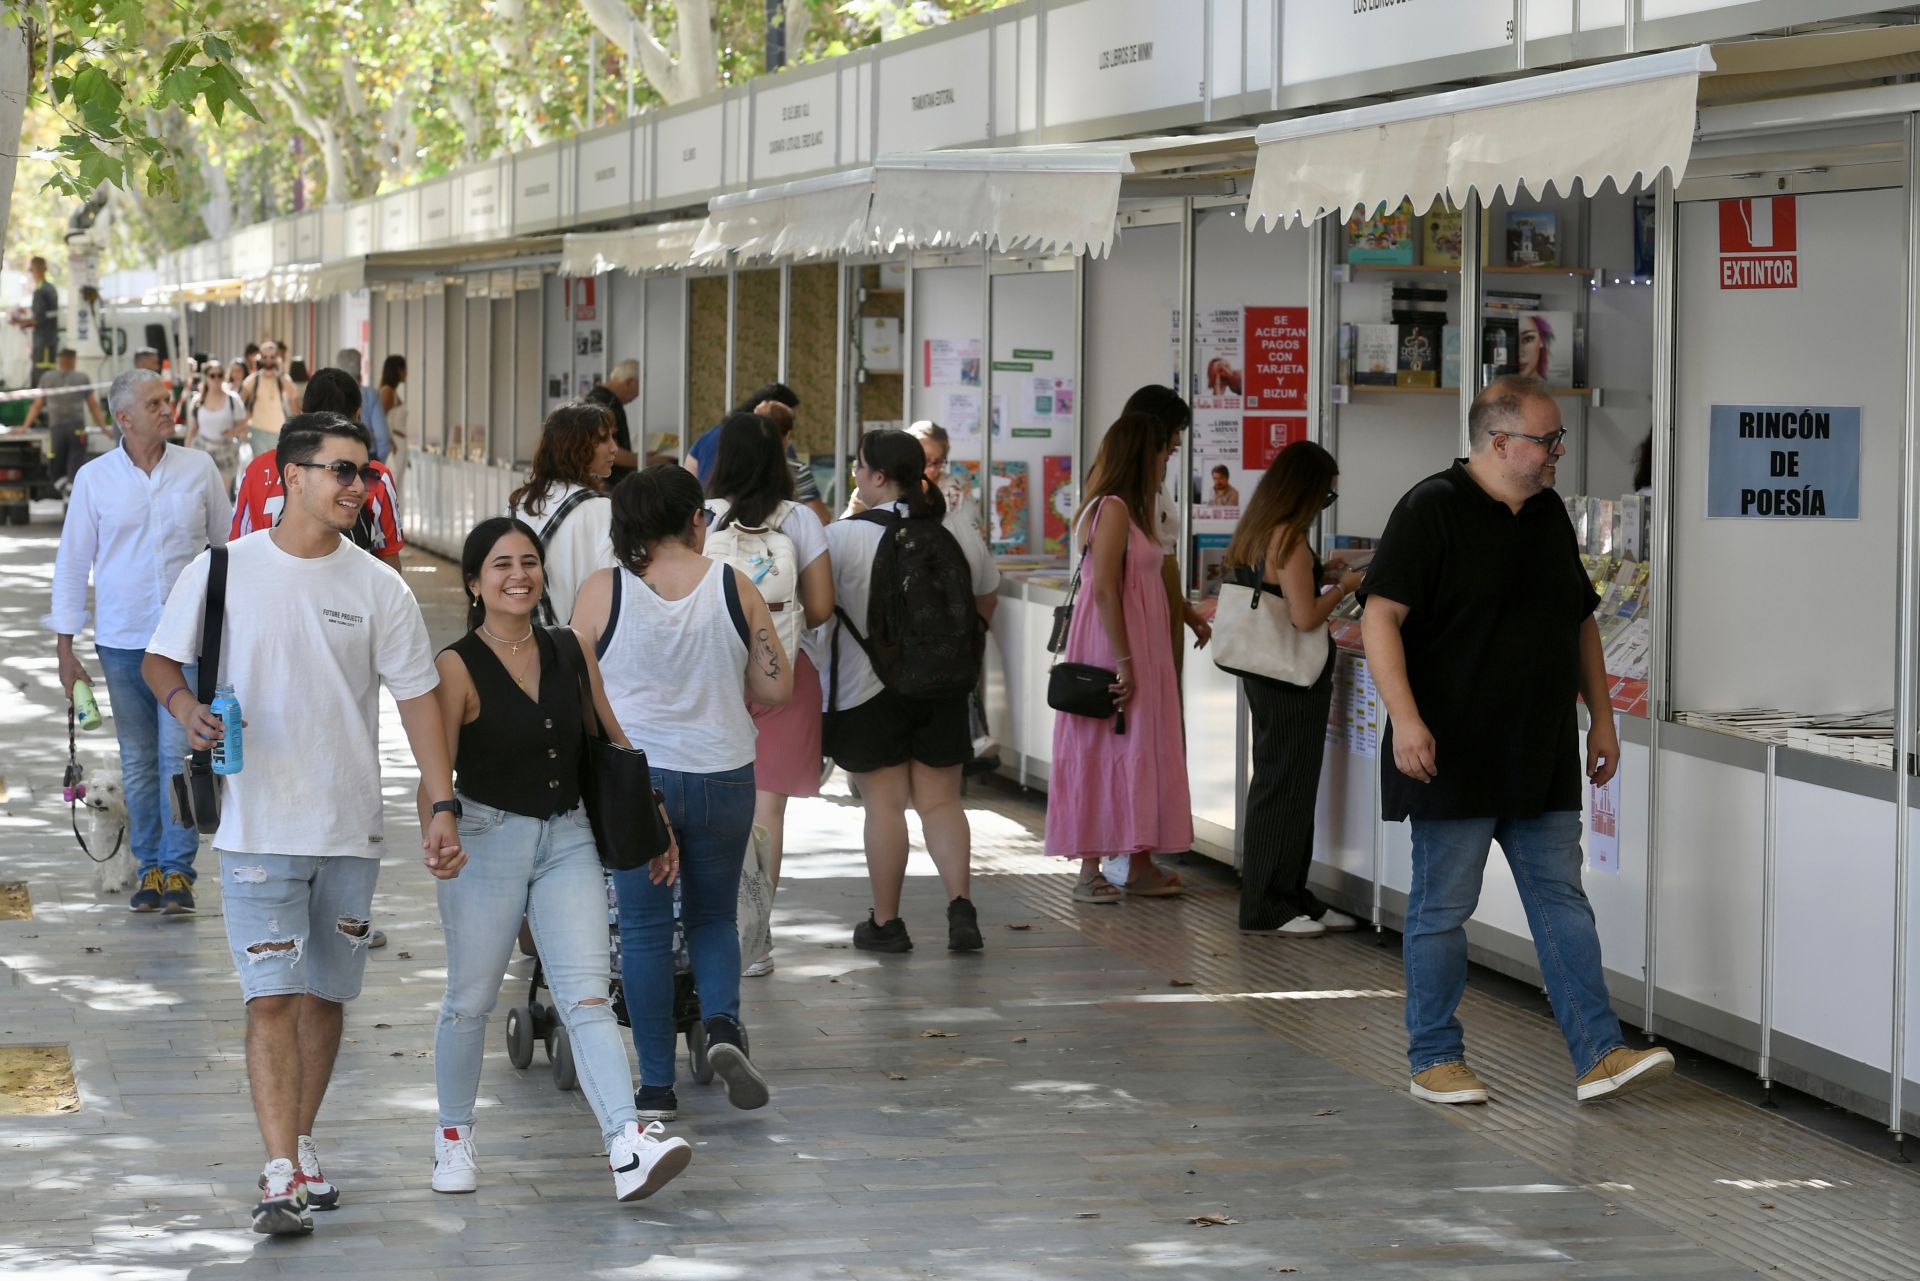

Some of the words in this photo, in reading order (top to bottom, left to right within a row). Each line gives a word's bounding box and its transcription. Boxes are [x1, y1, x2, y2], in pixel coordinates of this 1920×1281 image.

[1506, 20, 1513, 40] 59
[1723, 259, 1793, 286] EXTINTOR
[1273, 315, 1288, 325] SE
[1255, 328, 1306, 337] ACEPTAN
[1261, 340, 1300, 350] PAGOS
[1268, 352, 1293, 362] CON
[1256, 364, 1304, 374] TARJETA
[1276, 376, 1285, 386] Y
[1263, 388, 1297, 398] BIZUM
[1739, 409, 1830, 439] RINCÓN
[1770, 451, 1799, 477] DE
[1741, 485, 1826, 516] POESÍA
[322, 608, 340, 619] FUTURE
[341, 612, 363, 623] PROJECTS
